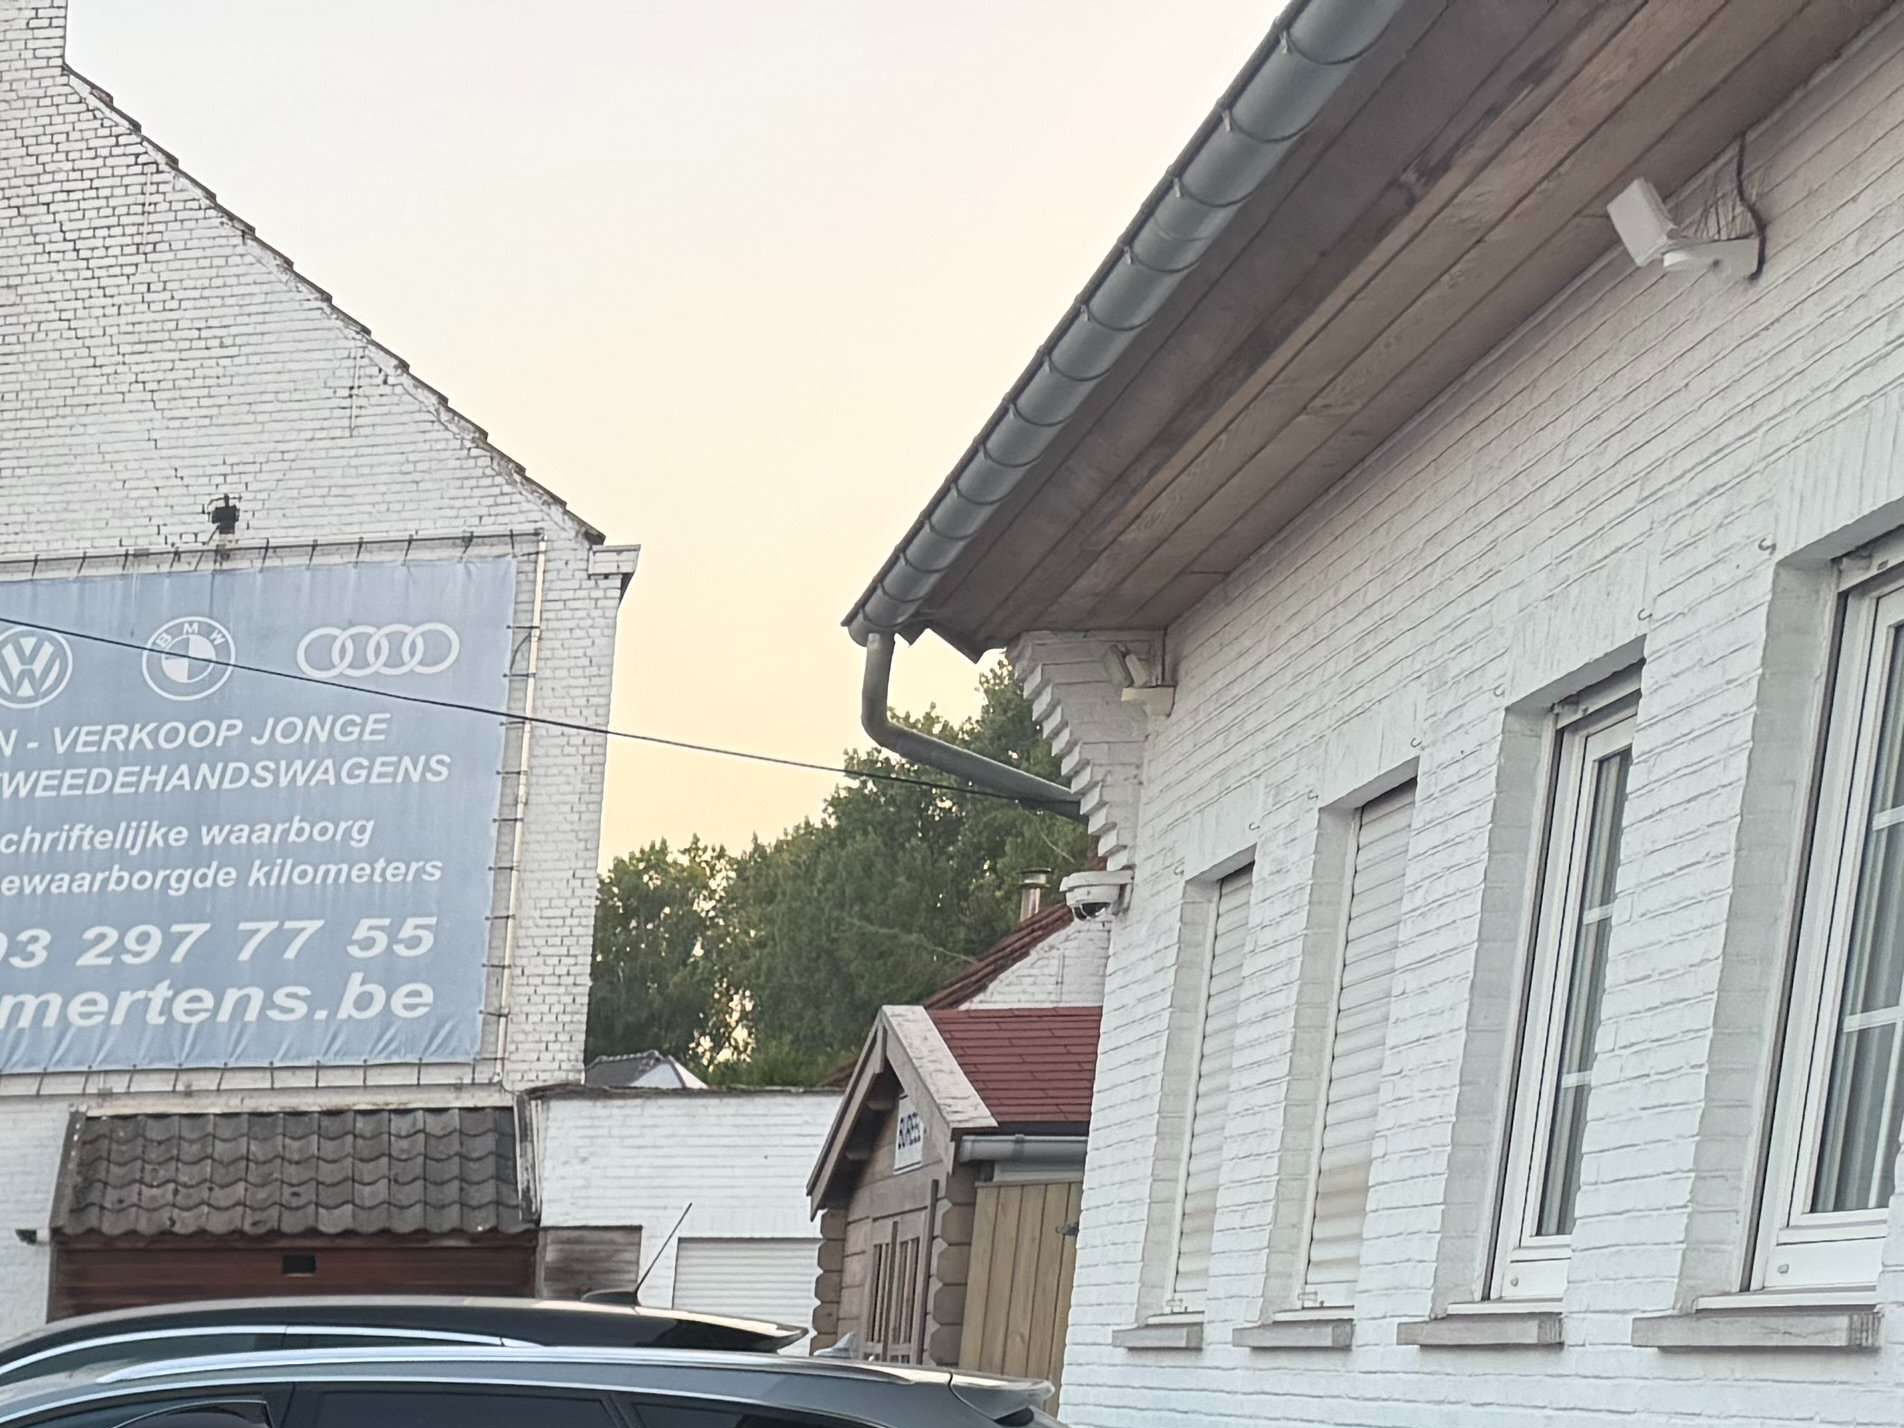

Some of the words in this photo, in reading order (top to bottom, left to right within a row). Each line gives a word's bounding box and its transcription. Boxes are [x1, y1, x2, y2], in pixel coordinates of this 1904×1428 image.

[52, 718, 244, 754] VERKOOP
[251, 712, 392, 748] JONGE
[199, 816, 375, 847] waarborg
[247, 856, 444, 888] kilometers
[75, 922, 210, 967] 297
[236, 918, 325, 962] 77
[346, 915, 438, 959] 55
